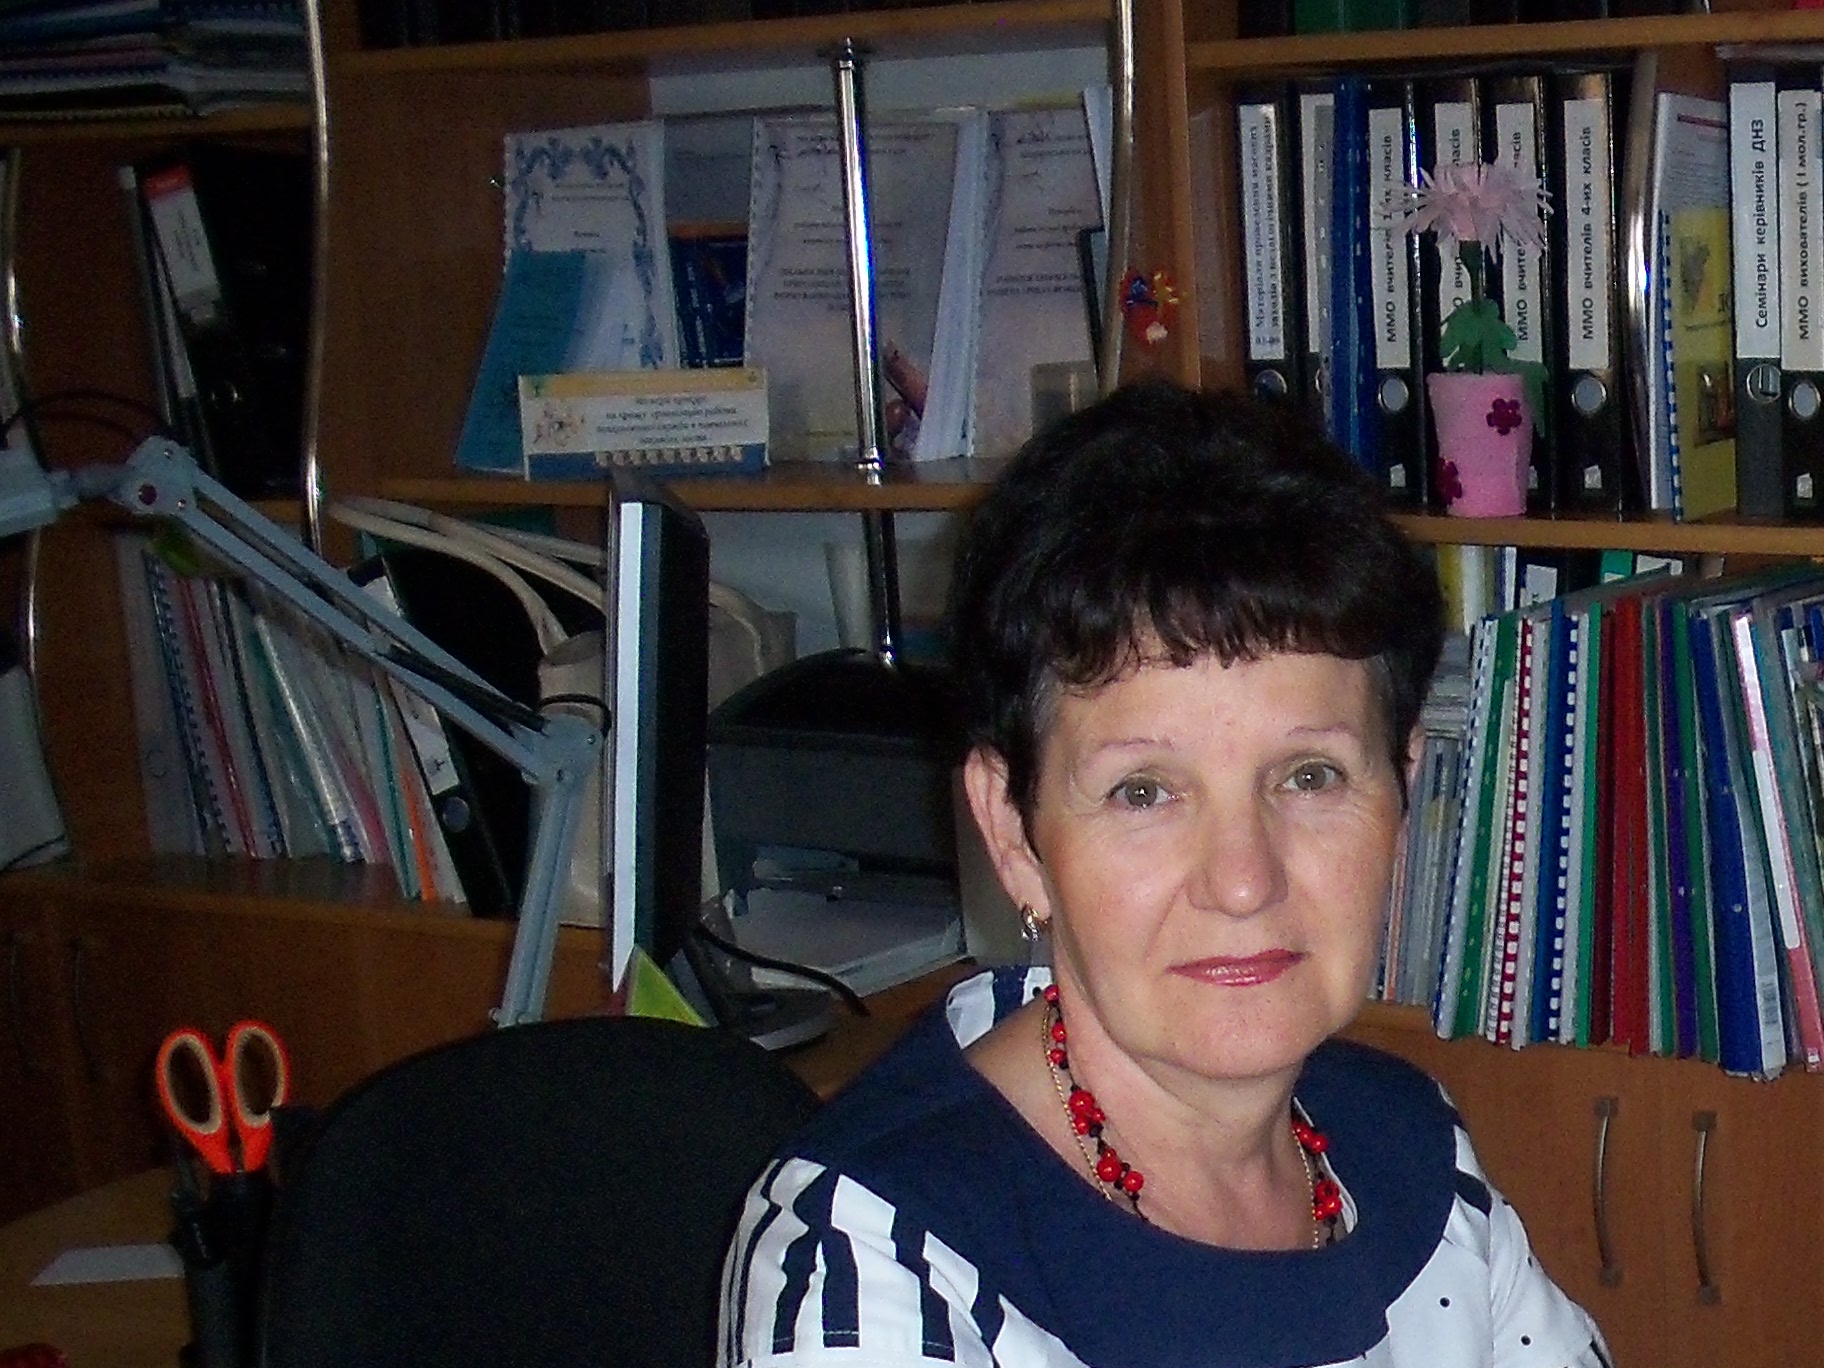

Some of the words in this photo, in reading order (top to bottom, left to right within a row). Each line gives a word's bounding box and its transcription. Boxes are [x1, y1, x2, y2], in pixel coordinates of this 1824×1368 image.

[1381, 135, 1393, 181] класів
[1581, 127, 1592, 175] класів
[1751, 119, 1766, 153] ДНЗ
[1581, 183, 1593, 215] 4-их
[1752, 161, 1768, 245] керівників
[1580, 223, 1593, 289] вчителів
[1796, 192, 1809, 287] вихователів
[1754, 253, 1770, 328] Семінари
[1385, 301, 1397, 343] ММО
[1516, 299, 1528, 341] ММО
[1581, 298, 1594, 339] ММО
[1797, 296, 1809, 340] ММО
